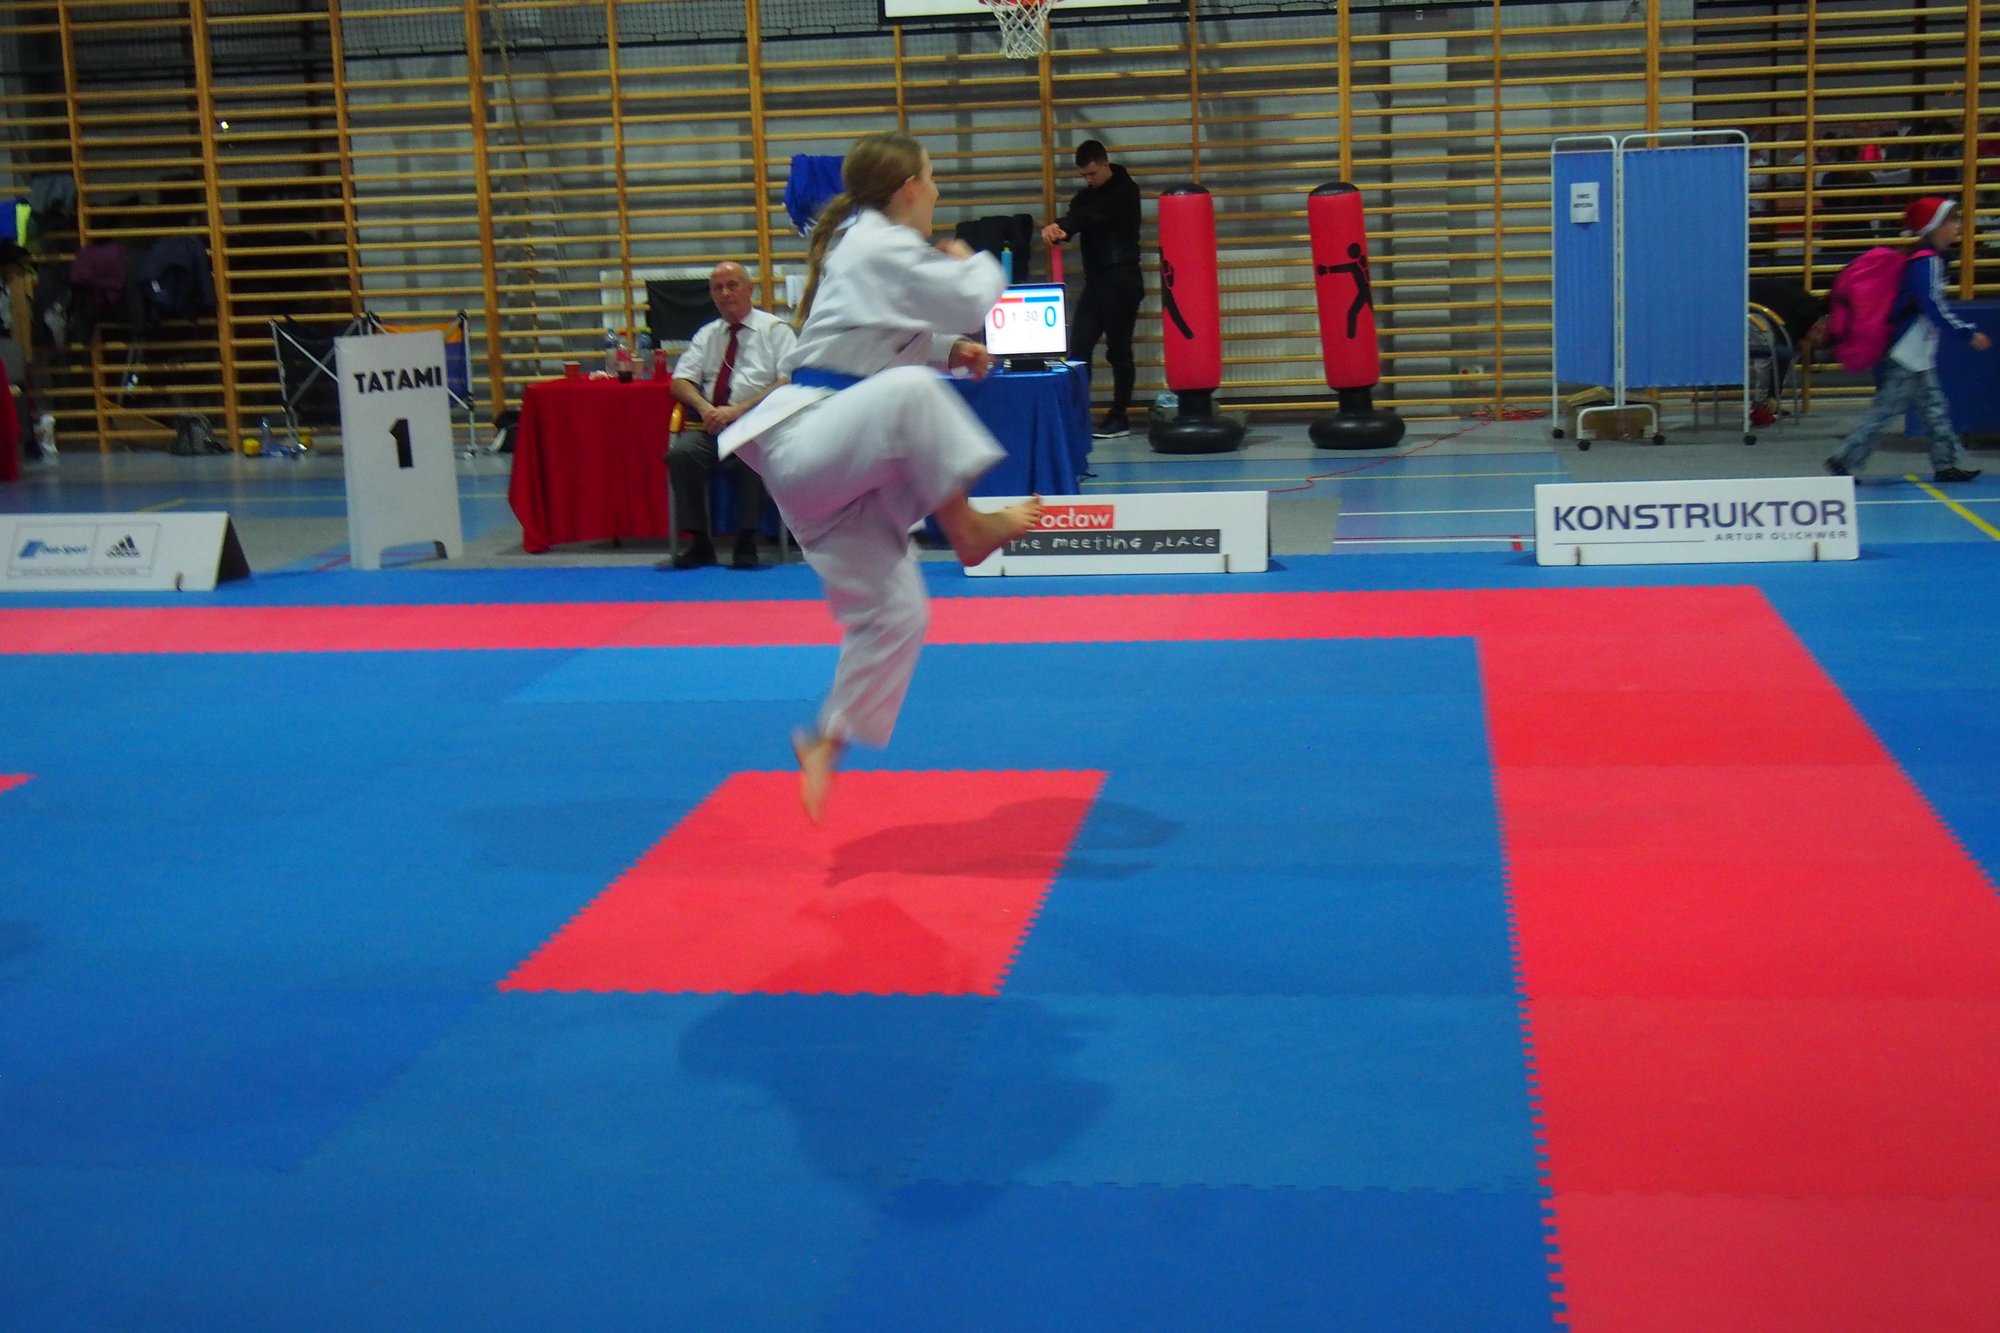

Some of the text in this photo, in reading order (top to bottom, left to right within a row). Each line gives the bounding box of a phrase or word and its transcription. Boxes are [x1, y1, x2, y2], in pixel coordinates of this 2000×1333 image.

[992, 308, 1005, 329] 0
[1024, 310, 1039, 322] 30
[1044, 306, 1057, 327] 0
[353, 366, 443, 394] TATAMI
[389, 418, 414, 469] 1
[1553, 499, 1847, 531] KONSTRUKTOR
[1714, 532, 1764, 541] ARTUR
